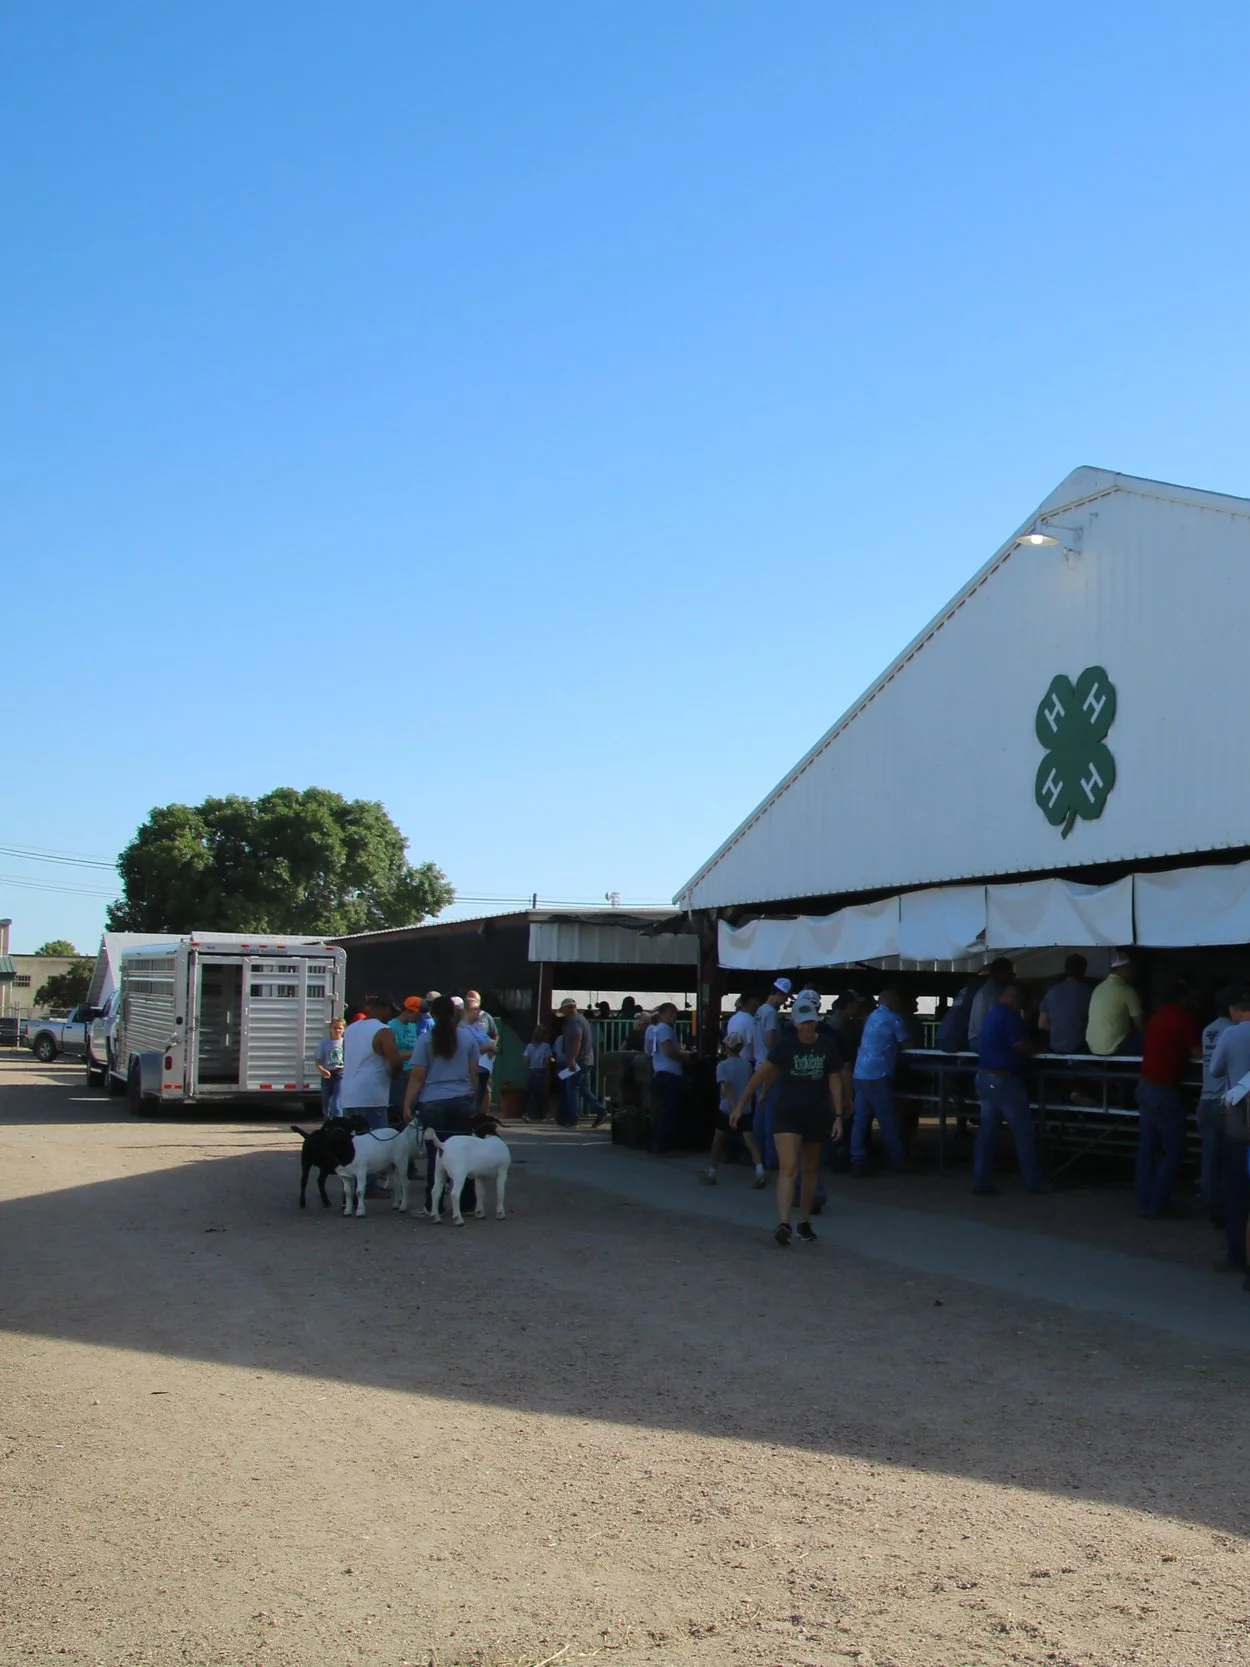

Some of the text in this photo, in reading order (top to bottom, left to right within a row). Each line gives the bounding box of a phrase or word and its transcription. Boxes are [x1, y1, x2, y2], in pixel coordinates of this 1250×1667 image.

[1044, 693, 1065, 733] H
[1082, 681, 1106, 724] H
[1041, 768, 1063, 808] H
[1080, 762, 1104, 803] H
